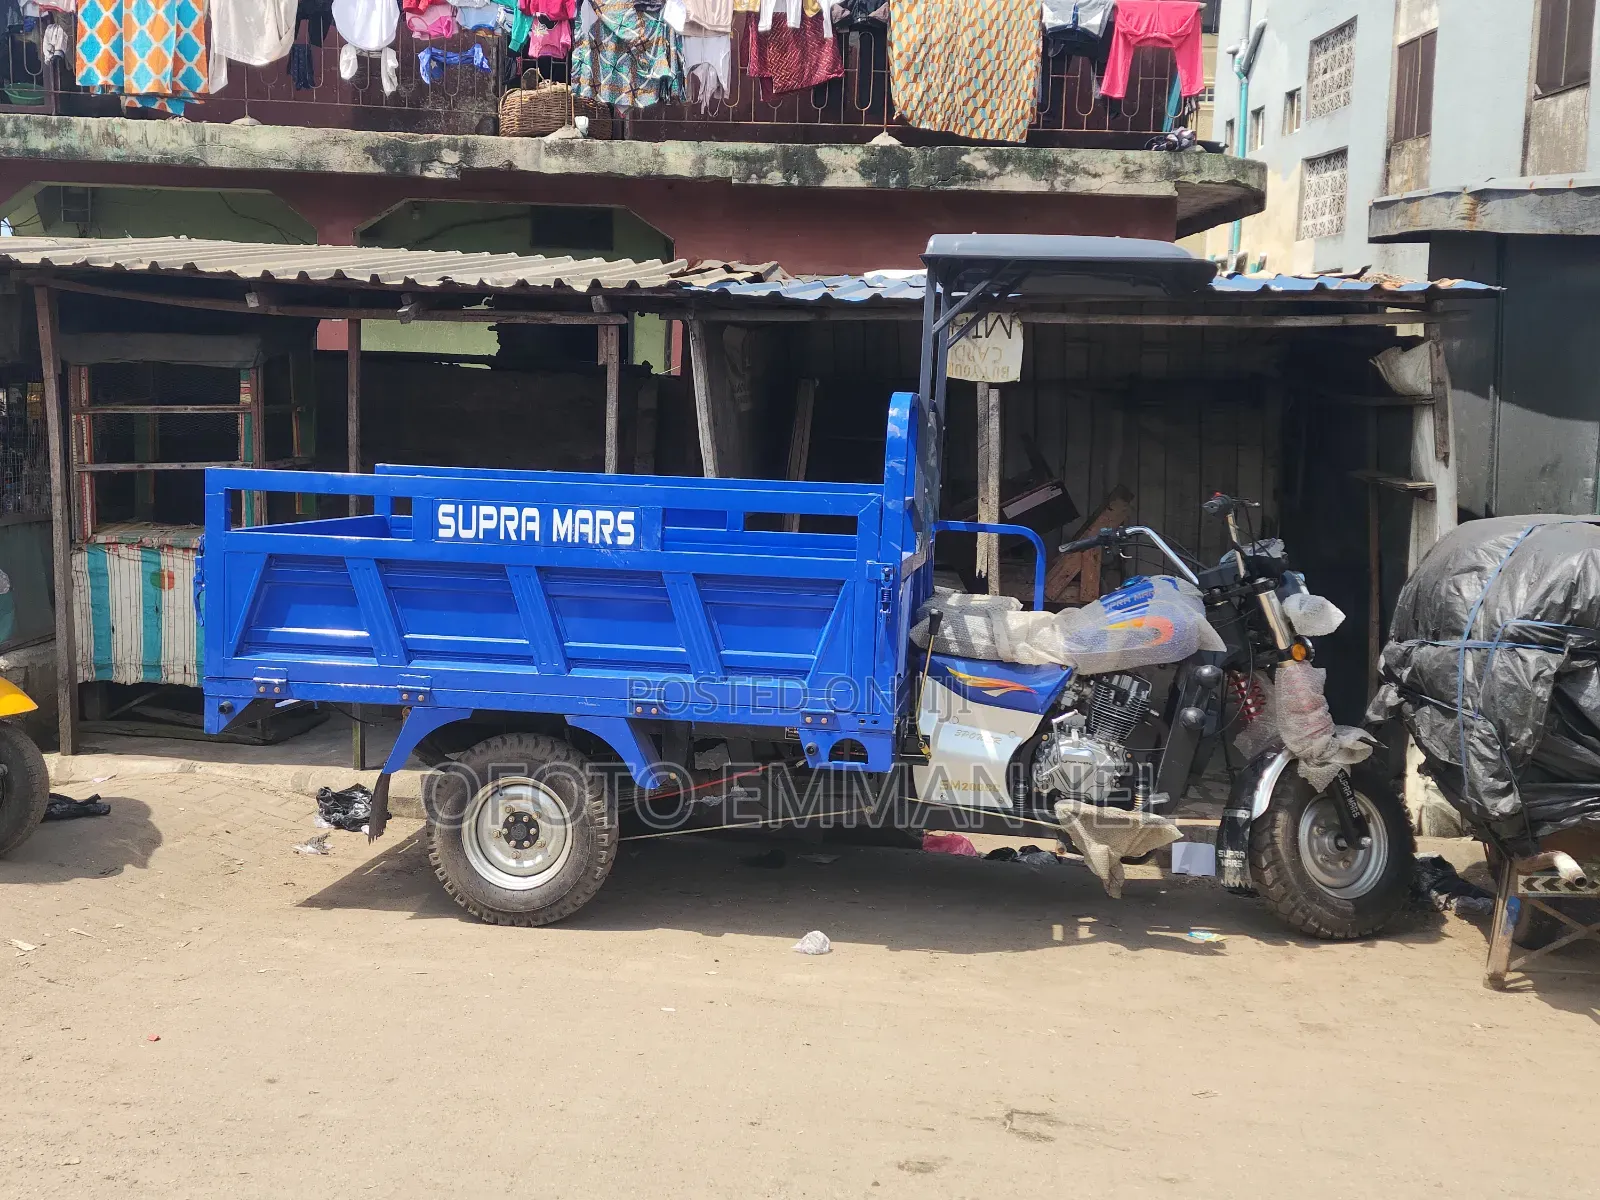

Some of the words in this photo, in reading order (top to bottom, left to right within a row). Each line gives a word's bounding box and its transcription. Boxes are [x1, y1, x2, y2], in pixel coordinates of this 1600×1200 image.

[951, 315, 1012, 340] MT
[438, 503, 540, 542] SUPRA
[552, 508, 635, 545] MARS
[1347, 796, 1360, 819] MARS
[1218, 849, 1246, 859] SUPRA
[1220, 858, 1243, 868] MARS
